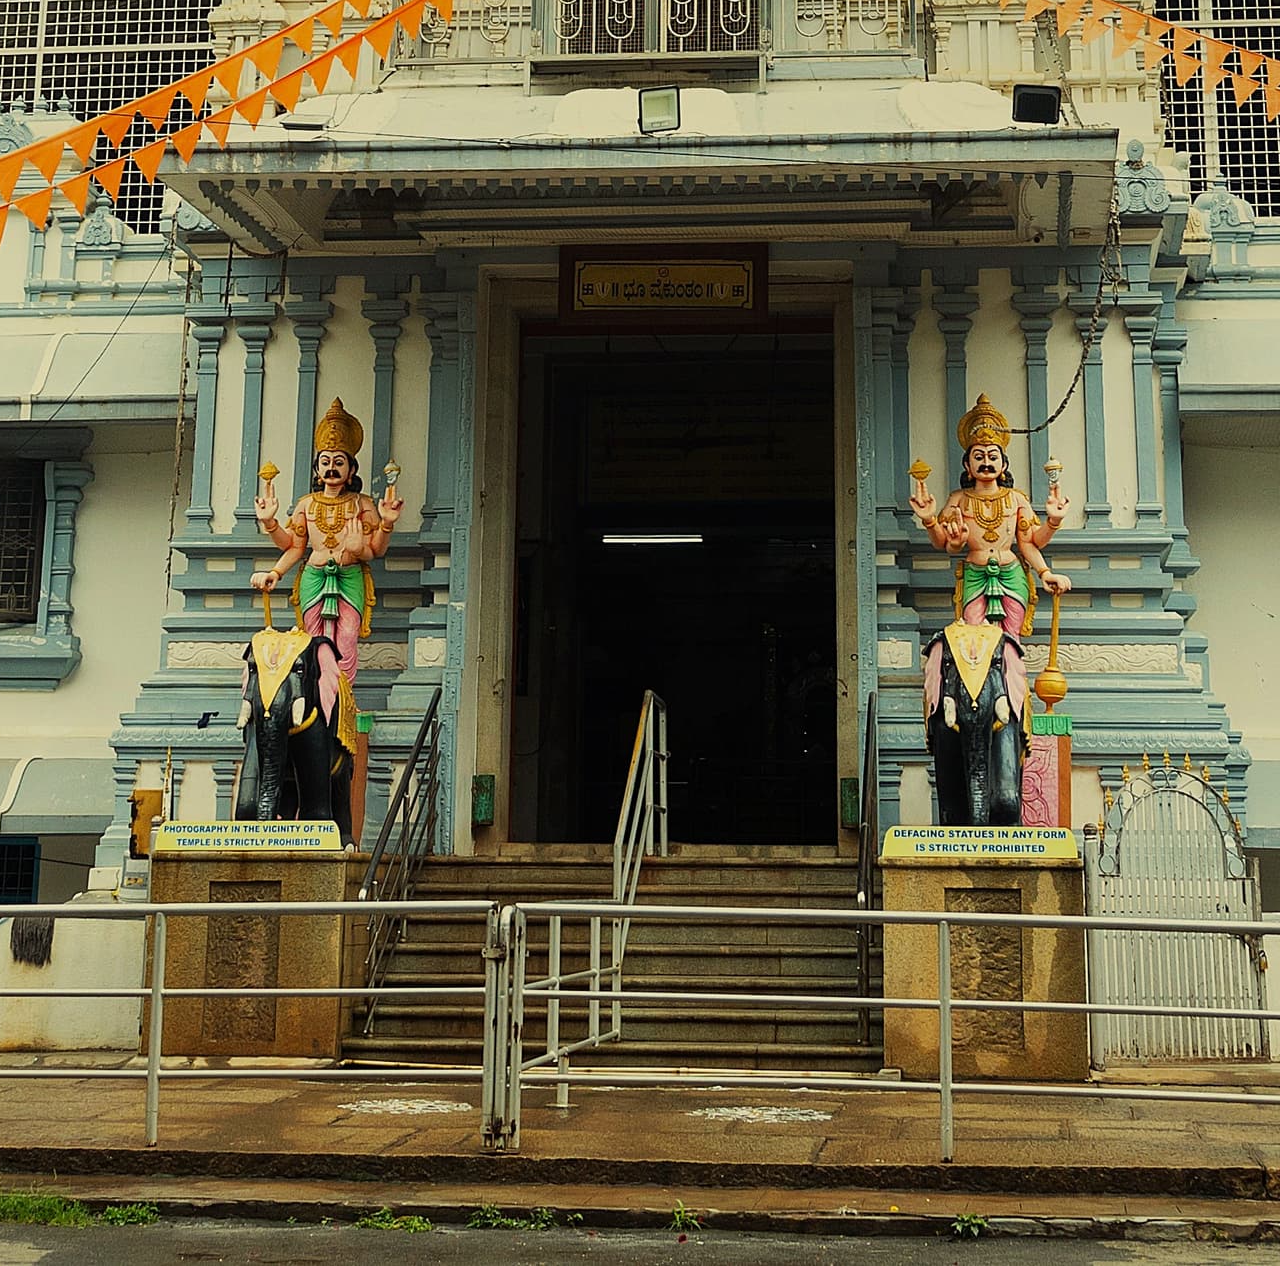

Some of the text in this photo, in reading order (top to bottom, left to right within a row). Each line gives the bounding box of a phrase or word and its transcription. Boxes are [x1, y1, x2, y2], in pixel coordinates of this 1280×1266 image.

[164, 824, 334, 833] PHOTOGRAPHY IN THE VICINITY OF THE
[894, 829, 1066, 838] DEFACING STATUES IN ANY FORM
[176, 838, 321, 846] TEMPLE IS STRICTLY PROHIBITED
[915, 843, 1045, 852] IS STRICTLY PROHIBITED
